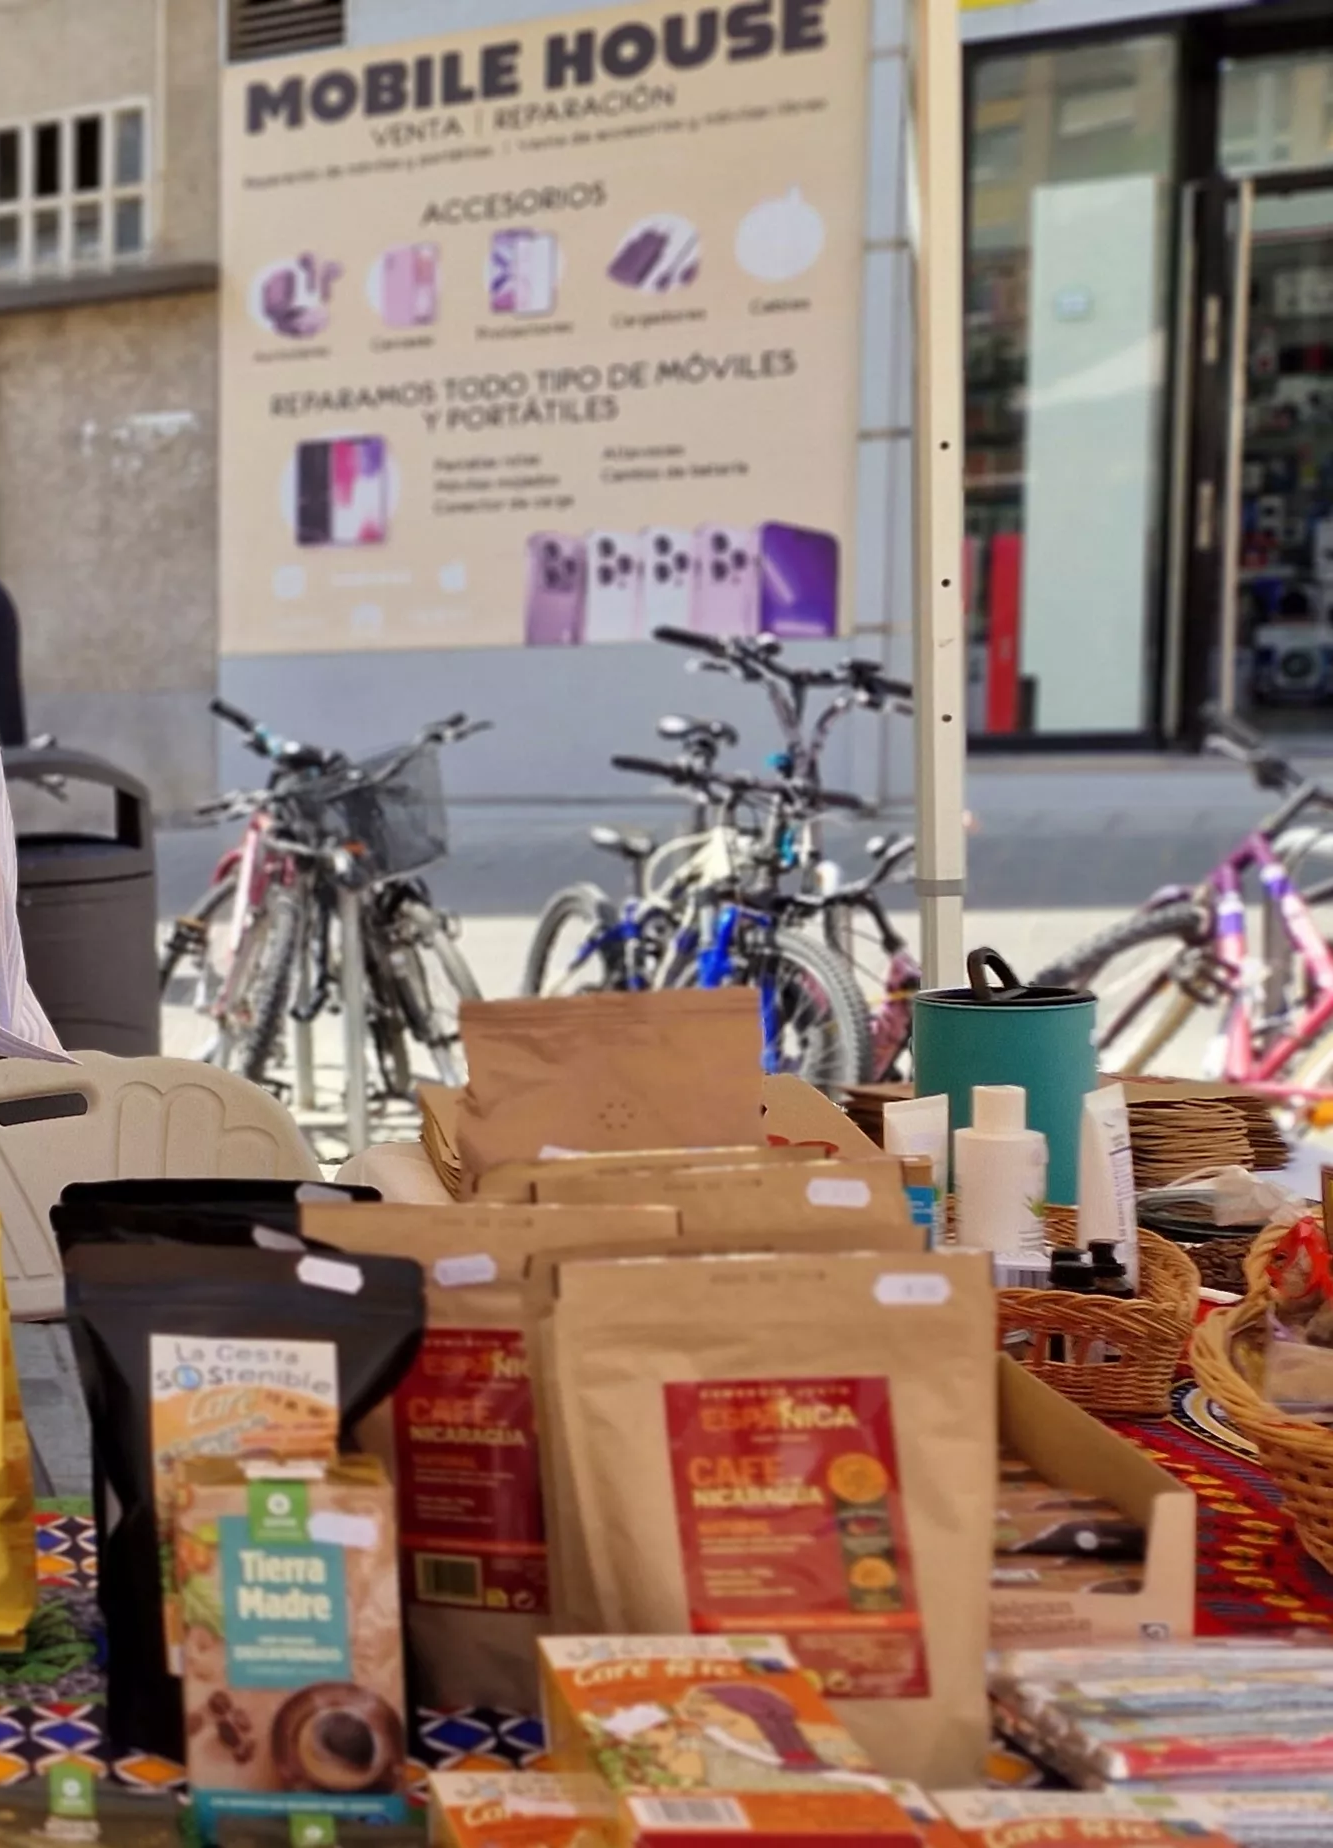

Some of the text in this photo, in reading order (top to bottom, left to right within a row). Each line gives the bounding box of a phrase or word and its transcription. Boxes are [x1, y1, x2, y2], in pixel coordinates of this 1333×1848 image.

[245, 0, 828, 136] MOBILE HOUSE
[370, 82, 677, 150] VENTA REPARACIÓN
[420, 181, 608, 228] ACCESORIOS
[270, 347, 798, 420] REPARAMOS TODO TIPO DE MÓVILES
[423, 392, 620, 436] Y PORTÁTILES
[174, 1342, 300, 1365] La Cesta
[408, 1424, 527, 1449] NICARAGUA
[693, 1486, 824, 1509] NICARAGUA
[238, 1550, 327, 1584] Tierra
[236, 1586, 333, 1621] Madre
